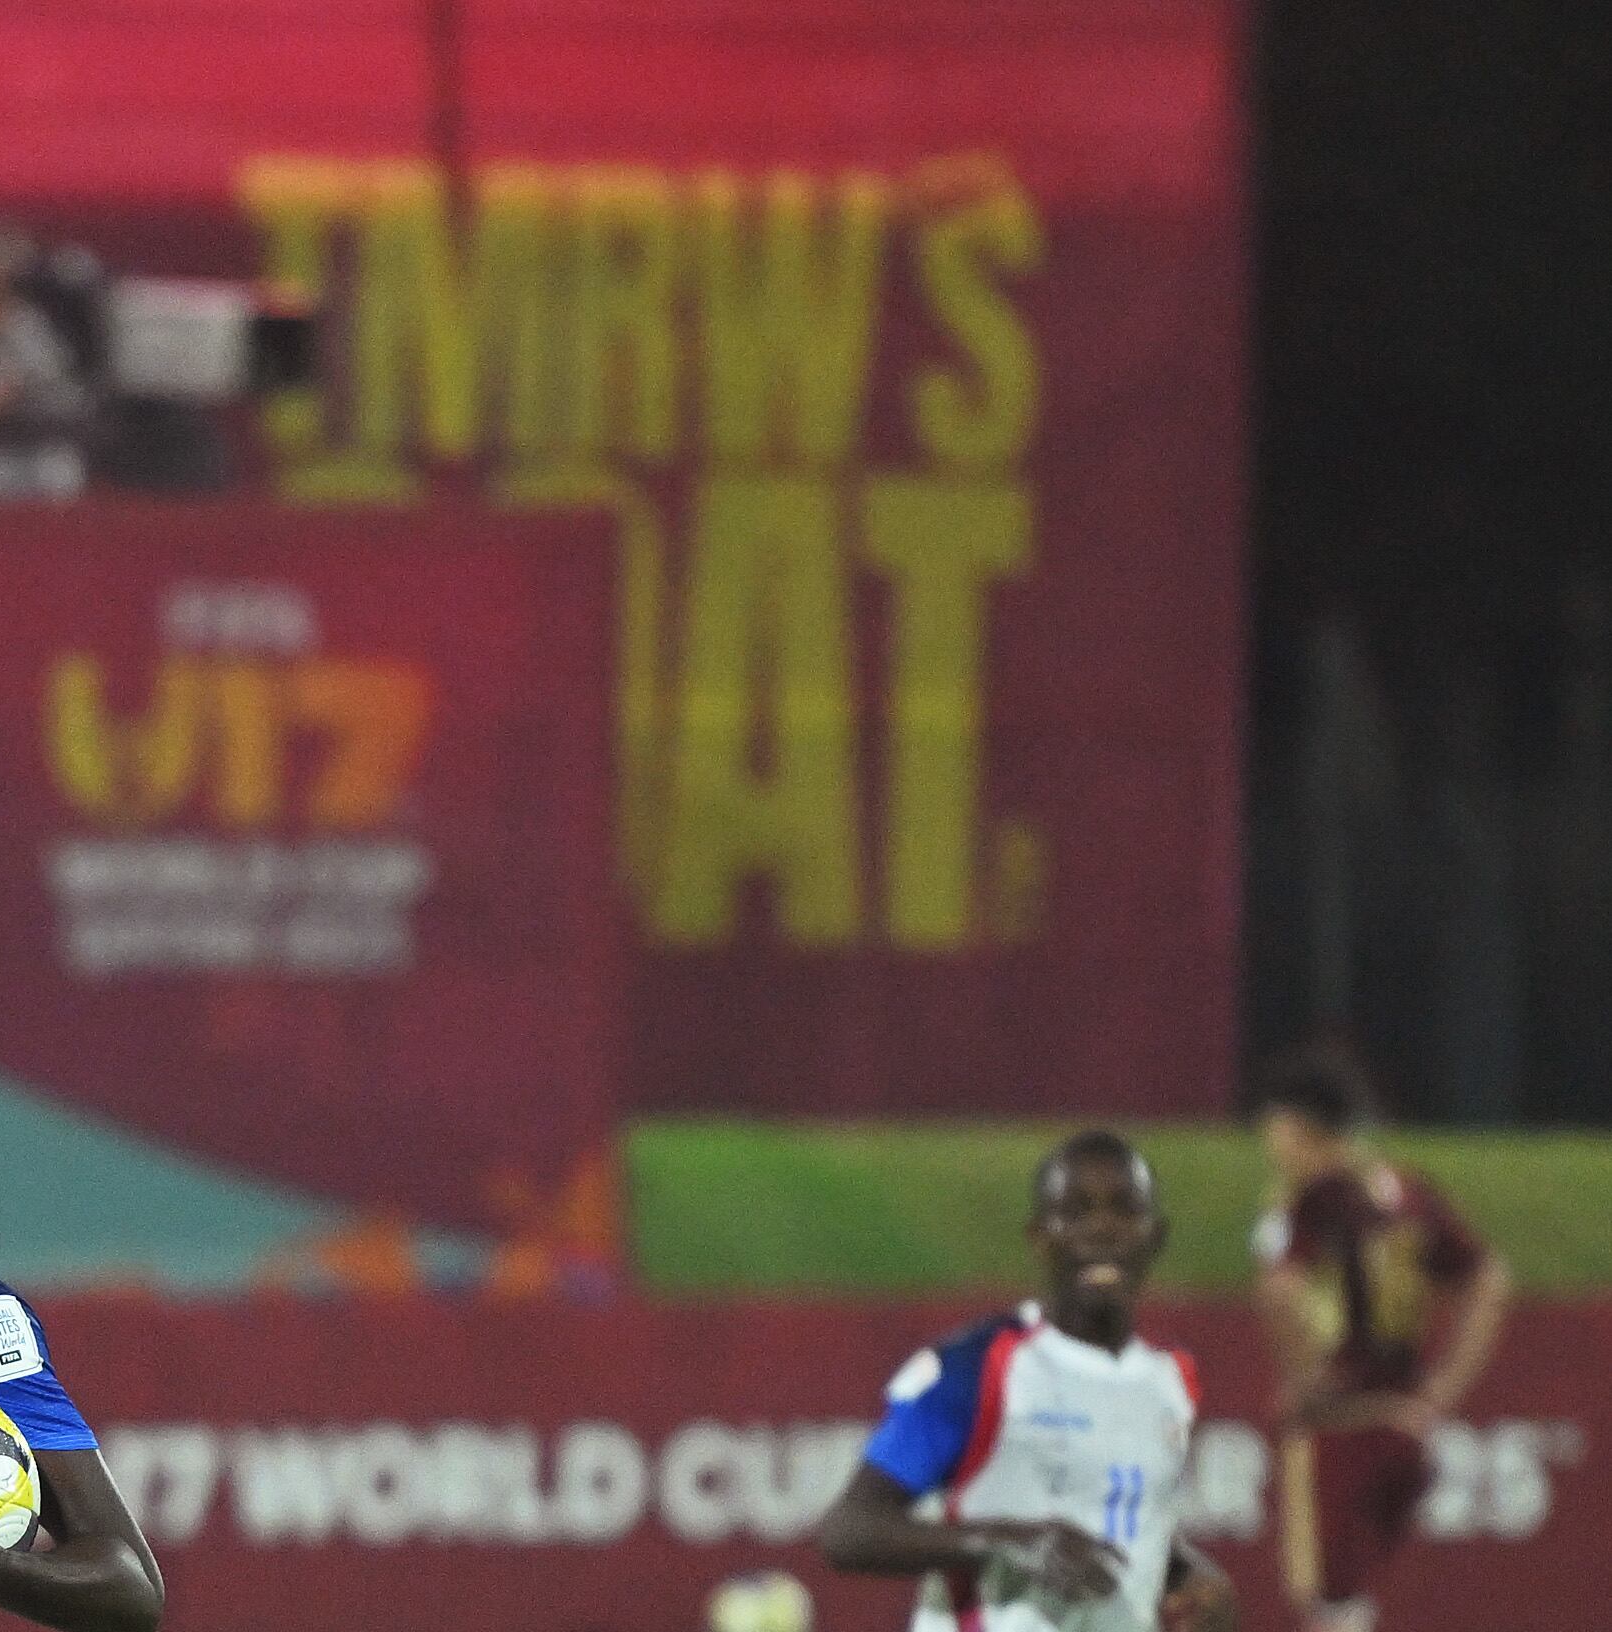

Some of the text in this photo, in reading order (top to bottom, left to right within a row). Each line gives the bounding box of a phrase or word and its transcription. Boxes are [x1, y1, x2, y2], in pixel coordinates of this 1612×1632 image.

[232, 1417, 646, 1547] WORLD
[657, 1417, 872, 1545] CU
[1104, 1462, 1144, 1541] 11
